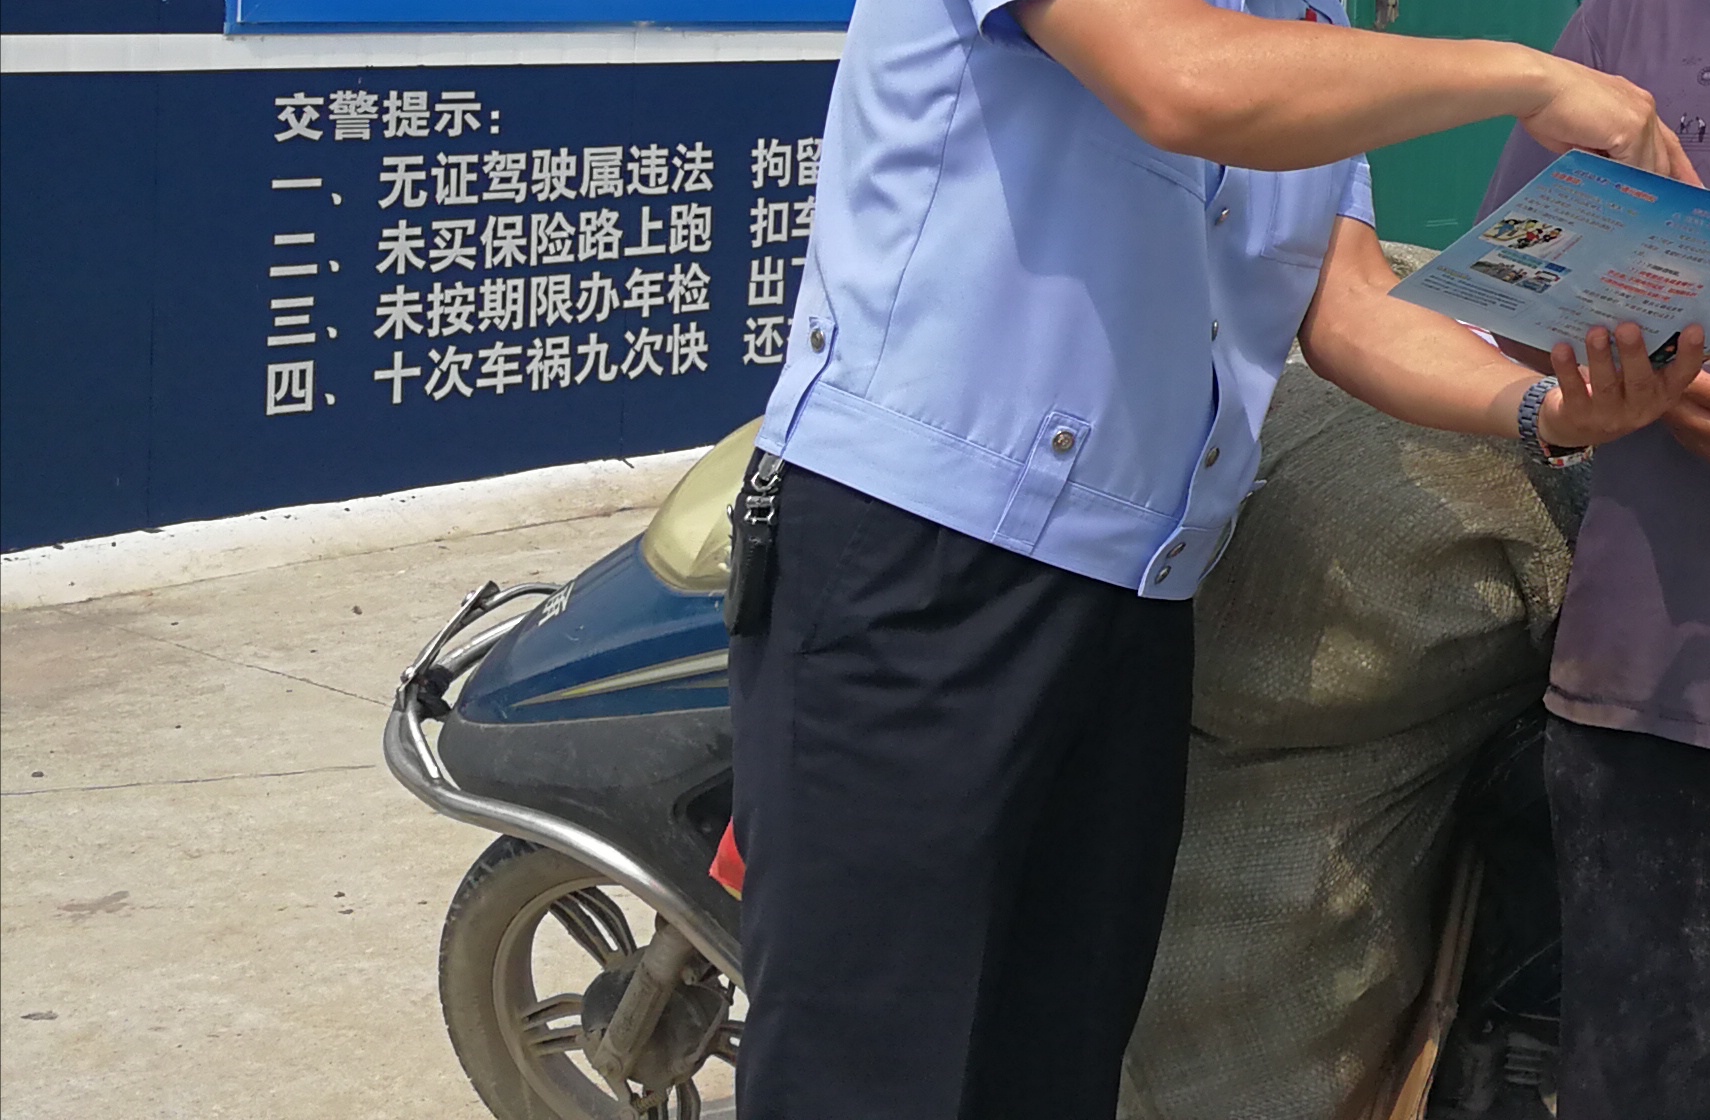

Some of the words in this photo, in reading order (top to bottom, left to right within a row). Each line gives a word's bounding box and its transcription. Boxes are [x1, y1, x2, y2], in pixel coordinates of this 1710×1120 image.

[378, 141, 714, 209] 无证驾驶属违法
[375, 202, 712, 275] 未买保险路上跑
[373, 262, 711, 340] 未按期限办年检
[373, 321, 708, 405] 十次车祸九次快
